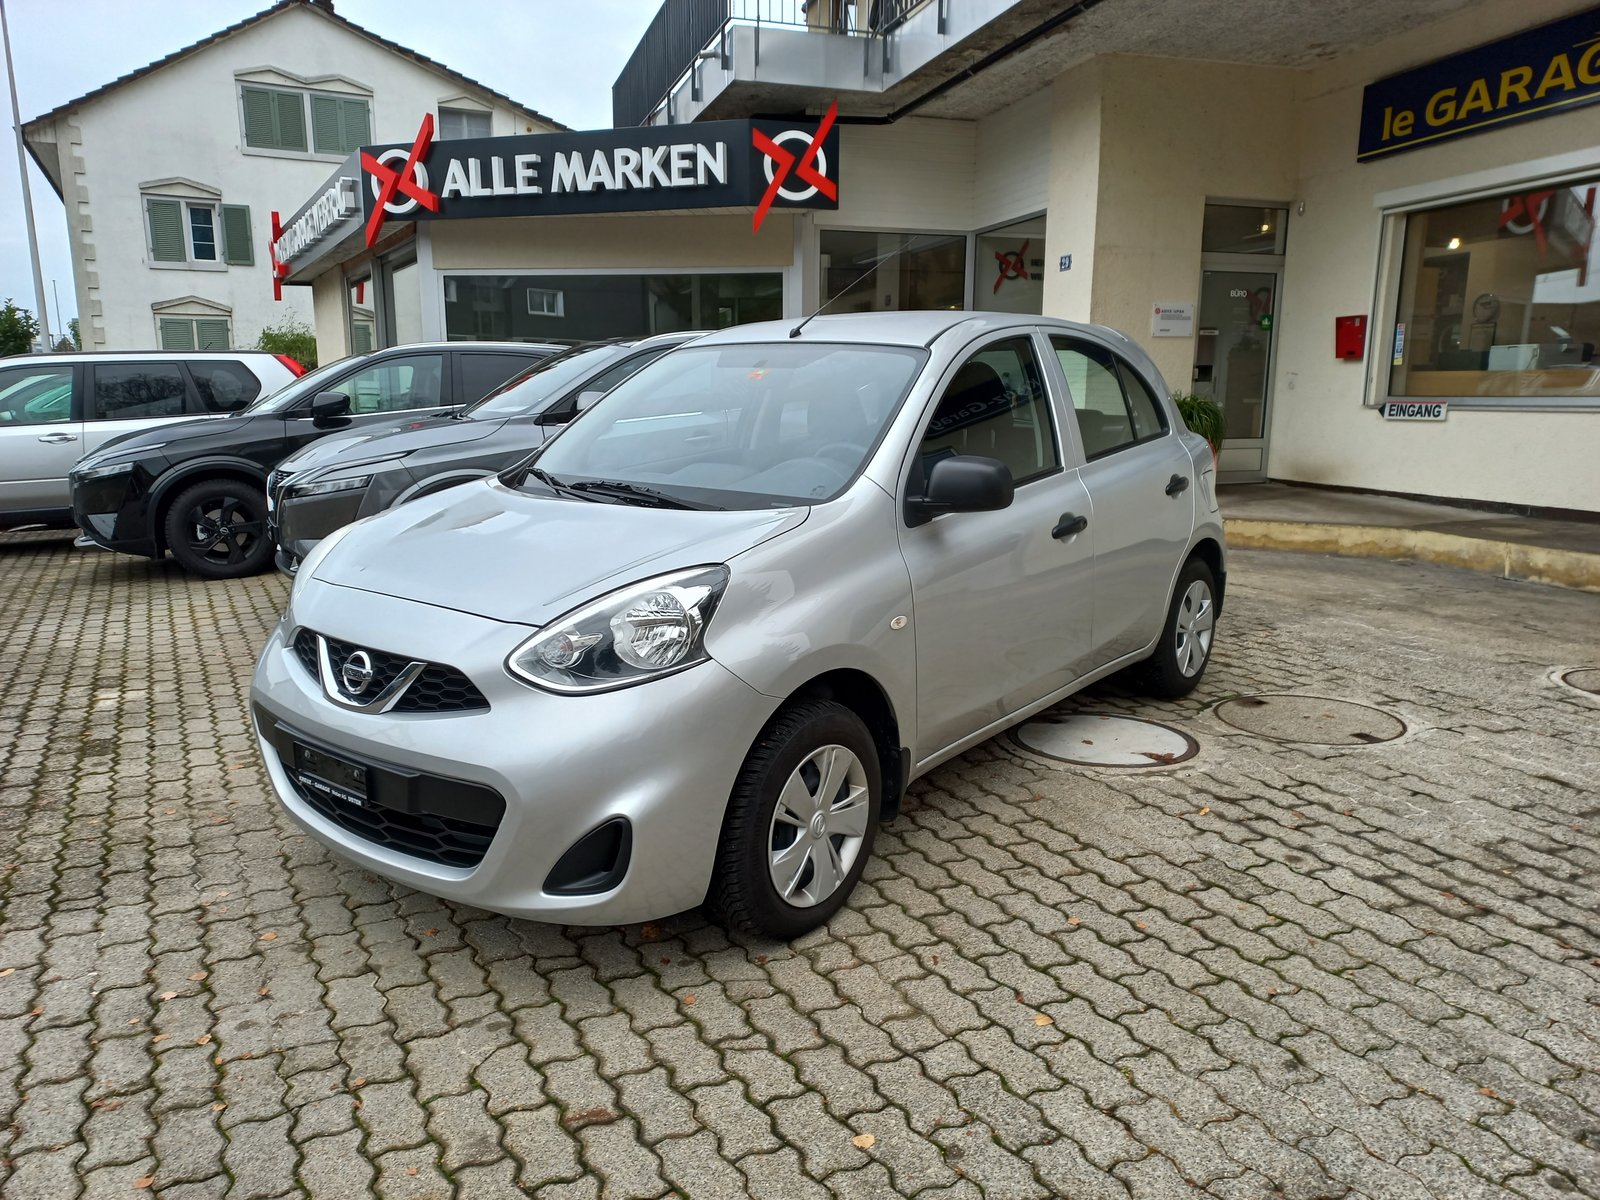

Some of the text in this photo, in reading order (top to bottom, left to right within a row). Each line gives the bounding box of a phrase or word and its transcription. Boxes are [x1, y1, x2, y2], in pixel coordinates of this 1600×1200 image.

[1381, 42, 1600, 141] le GARAG
[441, 141, 728, 198] ALLE MARKEN
[1061, 256, 1070, 269] 29
[1230, 288, 1247, 298] BÜRO
[1388, 404, 1442, 418] EINGANG
